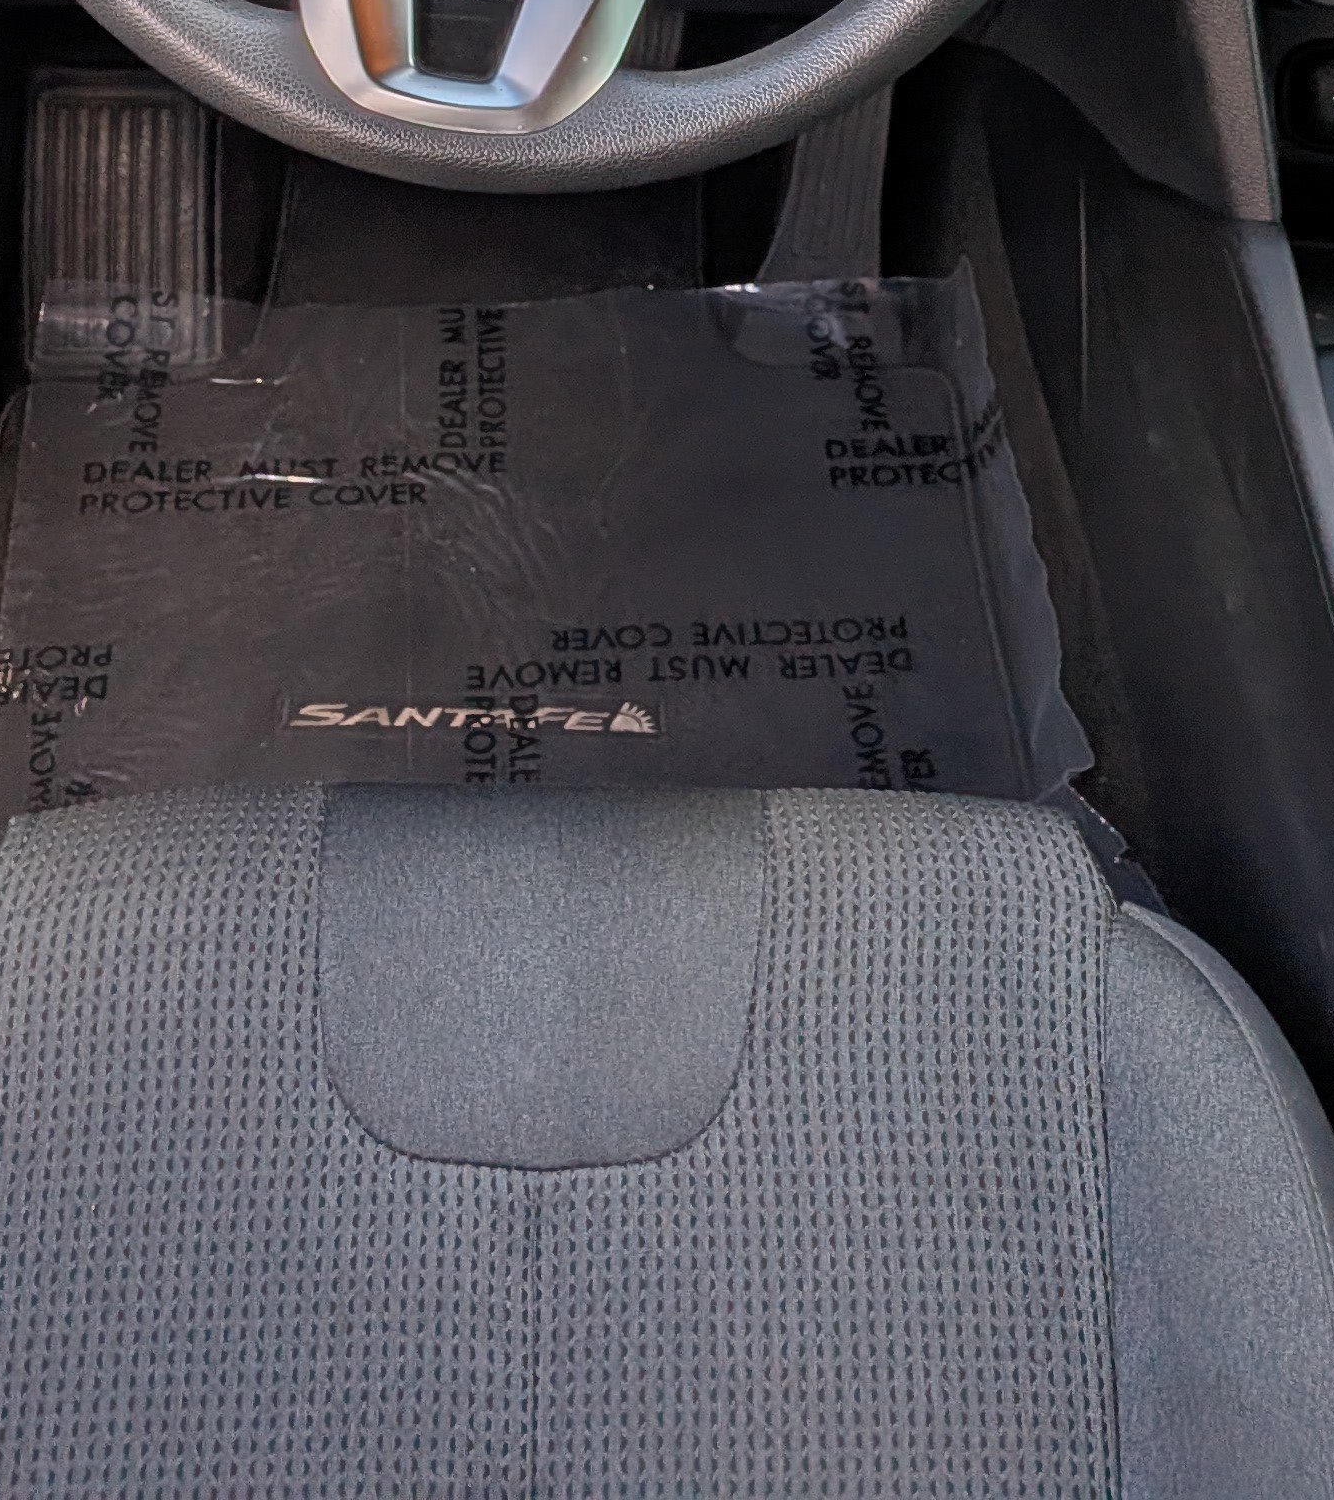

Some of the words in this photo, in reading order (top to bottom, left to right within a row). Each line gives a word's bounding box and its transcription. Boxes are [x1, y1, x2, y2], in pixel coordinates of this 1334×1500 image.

[476, 307, 506, 449] PROTECTIVE
[439, 359, 466, 449] DEALER
[825, 435, 950, 461] DEALER
[82, 459, 214, 485] DEALER
[238, 457, 339, 479] MUST
[78, 484, 293, 516] PROTECTIVE
[307, 482, 429, 507] COVER
[551, 622, 673, 652] COVER
[690, 614, 909, 647] PROTECTIVE
[466, 658, 623, 691] REMOVE
[648, 655, 751, 681] MUST
[779, 648, 914, 680] DEALER
